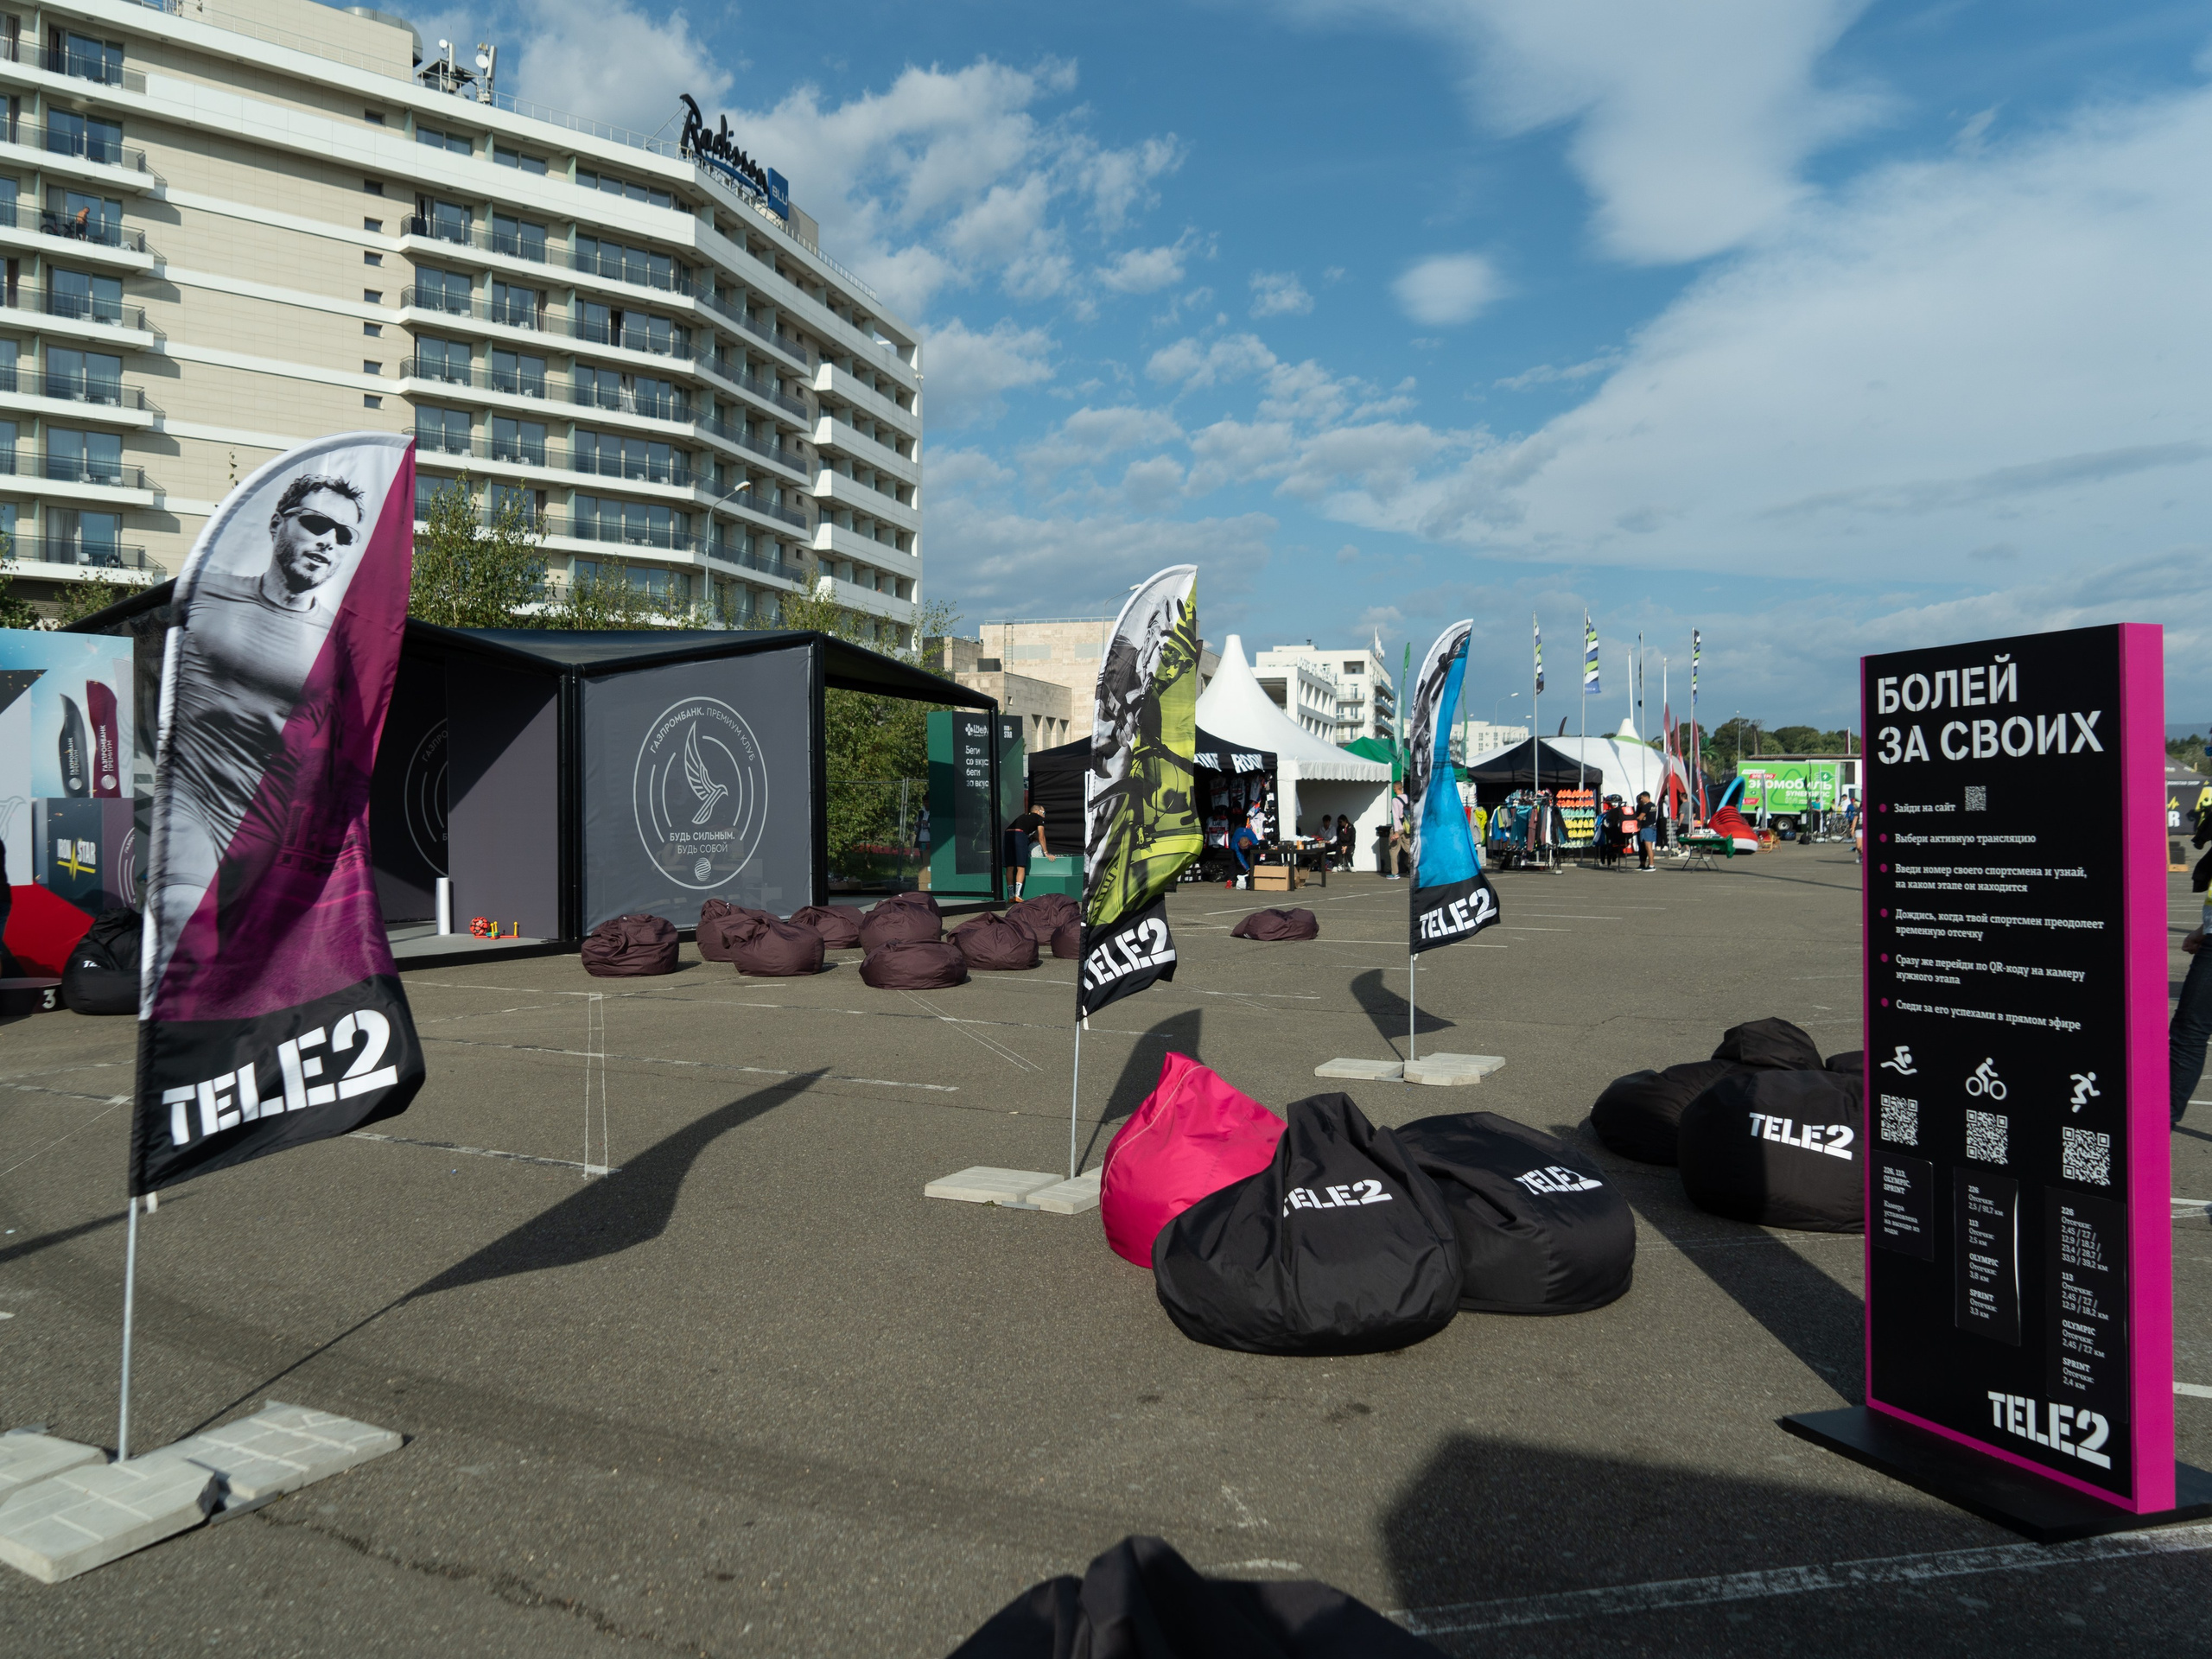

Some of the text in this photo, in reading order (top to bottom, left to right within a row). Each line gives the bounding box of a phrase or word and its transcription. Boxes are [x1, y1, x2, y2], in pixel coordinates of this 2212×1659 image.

[680, 93, 787, 205] Radisson BLU
[1878, 653, 2017, 715] БОЛЕЙ
[650, 708, 755, 760] ГАЗПРОМБАНК. ПРЕМИУМ КЛУБ
[1878, 710, 2104, 765] ЗА СВОИХ
[422, 730, 448, 762] ГАЗПРО
[966, 746, 980, 754] Беги
[1894, 804, 1920, 813] Зайди
[1935, 803, 1955, 811] сайт
[670, 832, 690, 842] БУДЬ
[1895, 834, 2036, 845] Выбери активную трансляцию
[77, 841, 96, 865] STAR
[677, 842, 728, 855] БУДЬ СОБОЙ
[1895, 864, 1922, 874] Введи
[1923, 866, 1951, 876] номер
[1954, 867, 1983, 875] своего
[1985, 868, 2042, 878] спортсмена
[2055, 868, 2087, 879] узнай,
[1978, 883, 2028, 893] находится
[1420, 888, 1497, 938] TELE2
[1896, 909, 2104, 929] Дождись, когда твой спортсмен преодолеет
[1896, 926, 1983, 941] временную отсечку
[1896, 954, 1919, 967] Сразу
[1936, 959, 1974, 970] перейди
[1989, 962, 2029, 976] QR-коду
[2031, 967, 2044, 976] на
[2045, 969, 2085, 982] камеру
[1896, 971, 1961, 984] нужного этапа
[41, 988, 56, 1009] 3
[1896, 1000, 1922, 1012] Следи
[1935, 1006, 1948, 1015] его
[1951, 1007, 1995, 1020] успехами
[2005, 1014, 2046, 1026] прямом
[2049, 1017, 2081, 1032] эфире
[162, 1009, 397, 1146] TELE2
[1749, 1112, 1853, 1160] TELE2
[1884, 1184, 1905, 1194] SPRINT
[2061, 1206, 2074, 1216] 226
[2062, 1225, 2075, 1235] 2,45
[2062, 1235, 2075, 1244] 12,9
[2082, 1239, 2094, 1249] 18,2
[1969, 1253, 1999, 1267] OLYMPIC
[2062, 1272, 2074, 1281] 113
[1969, 1288, 1994, 1302] SPRINT
[2062, 1291, 2076, 1301] 2,45
[2062, 1300, 2075, 1311] 12,9
[2082, 1306, 2096, 1317] 18,2
[2063, 1319, 2096, 1336] OLYMPIC
[2063, 1338, 2076, 1349] 2,45
[2094, 1350, 2105, 1358] км
[2063, 1357, 2090, 1372] SPRINT
[2063, 1376, 2086, 1390] 2,4 км
[1988, 1390, 2111, 1470] TELE2
